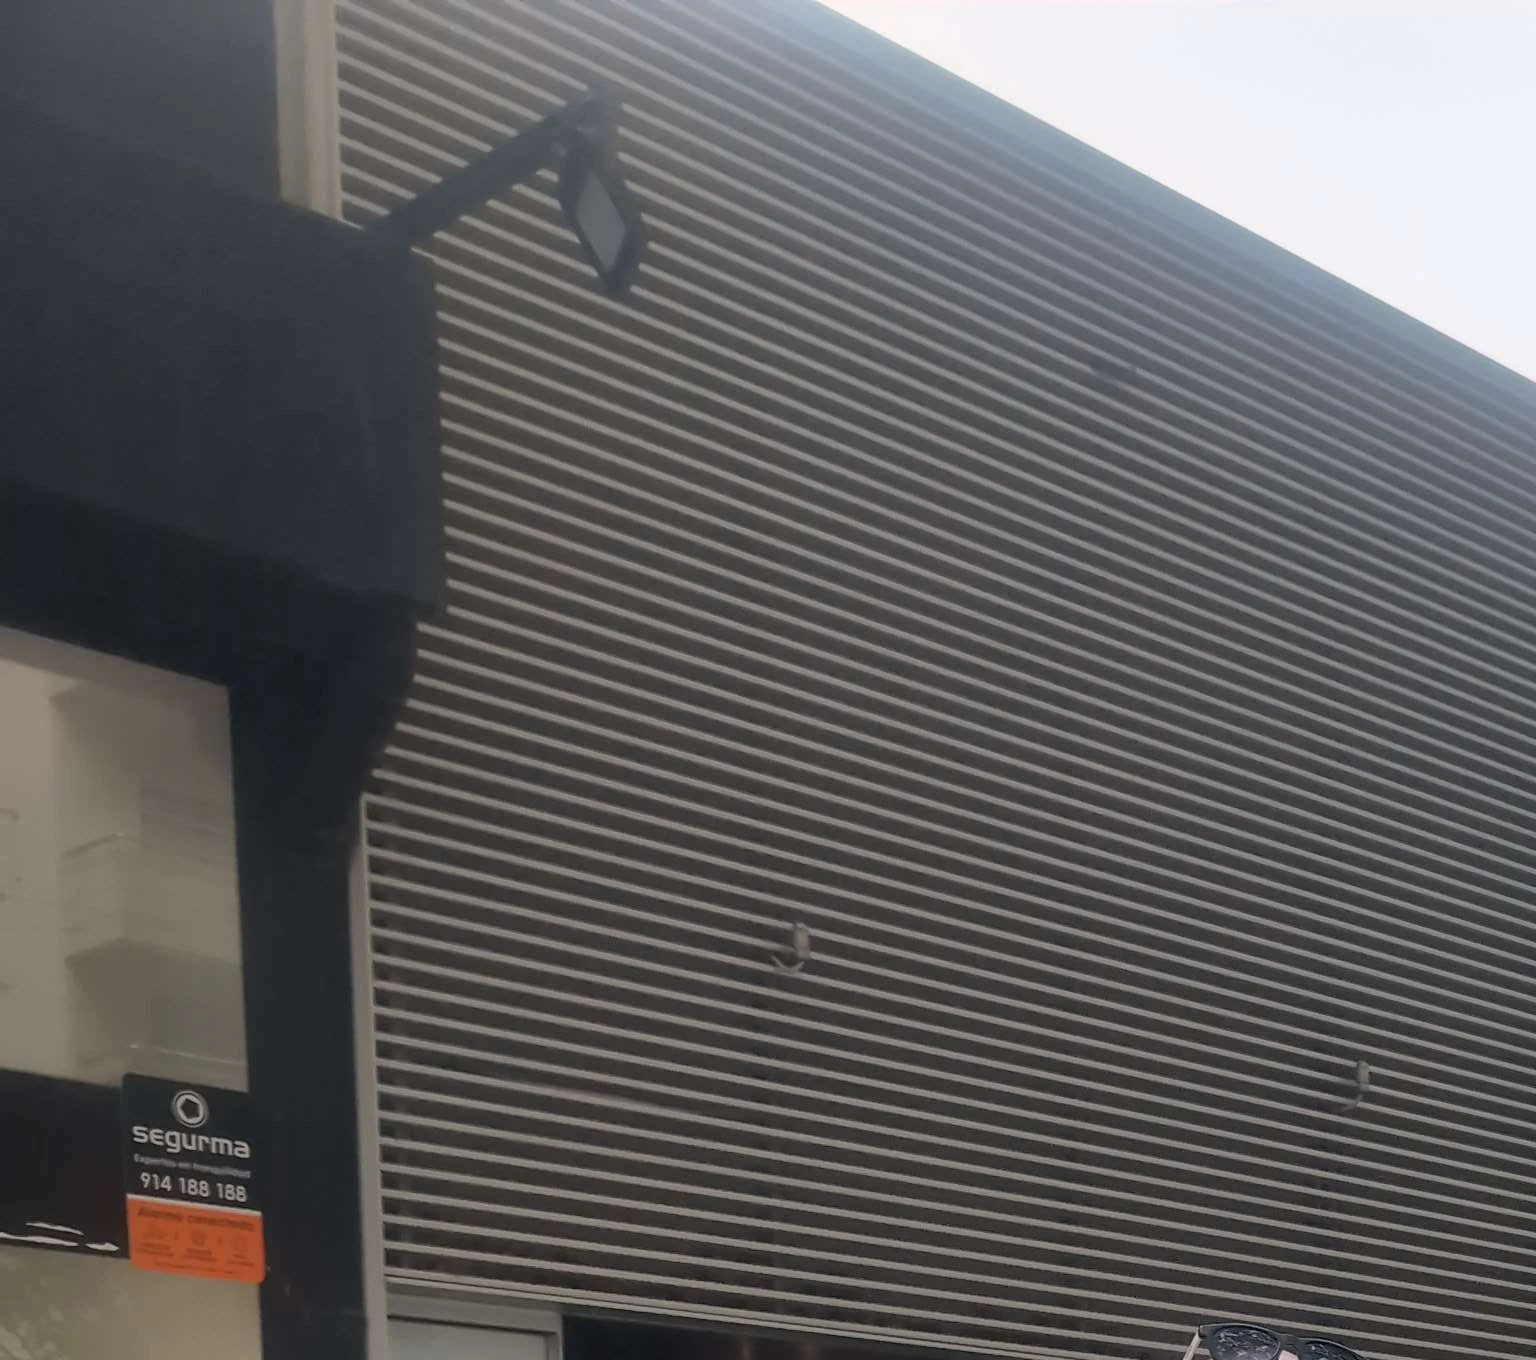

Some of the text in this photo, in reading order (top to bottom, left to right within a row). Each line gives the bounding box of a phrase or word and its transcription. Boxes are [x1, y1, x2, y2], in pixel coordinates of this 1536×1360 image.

[131, 1125, 251, 1159] segurma
[140, 1172, 247, 1202] 914 188 188
